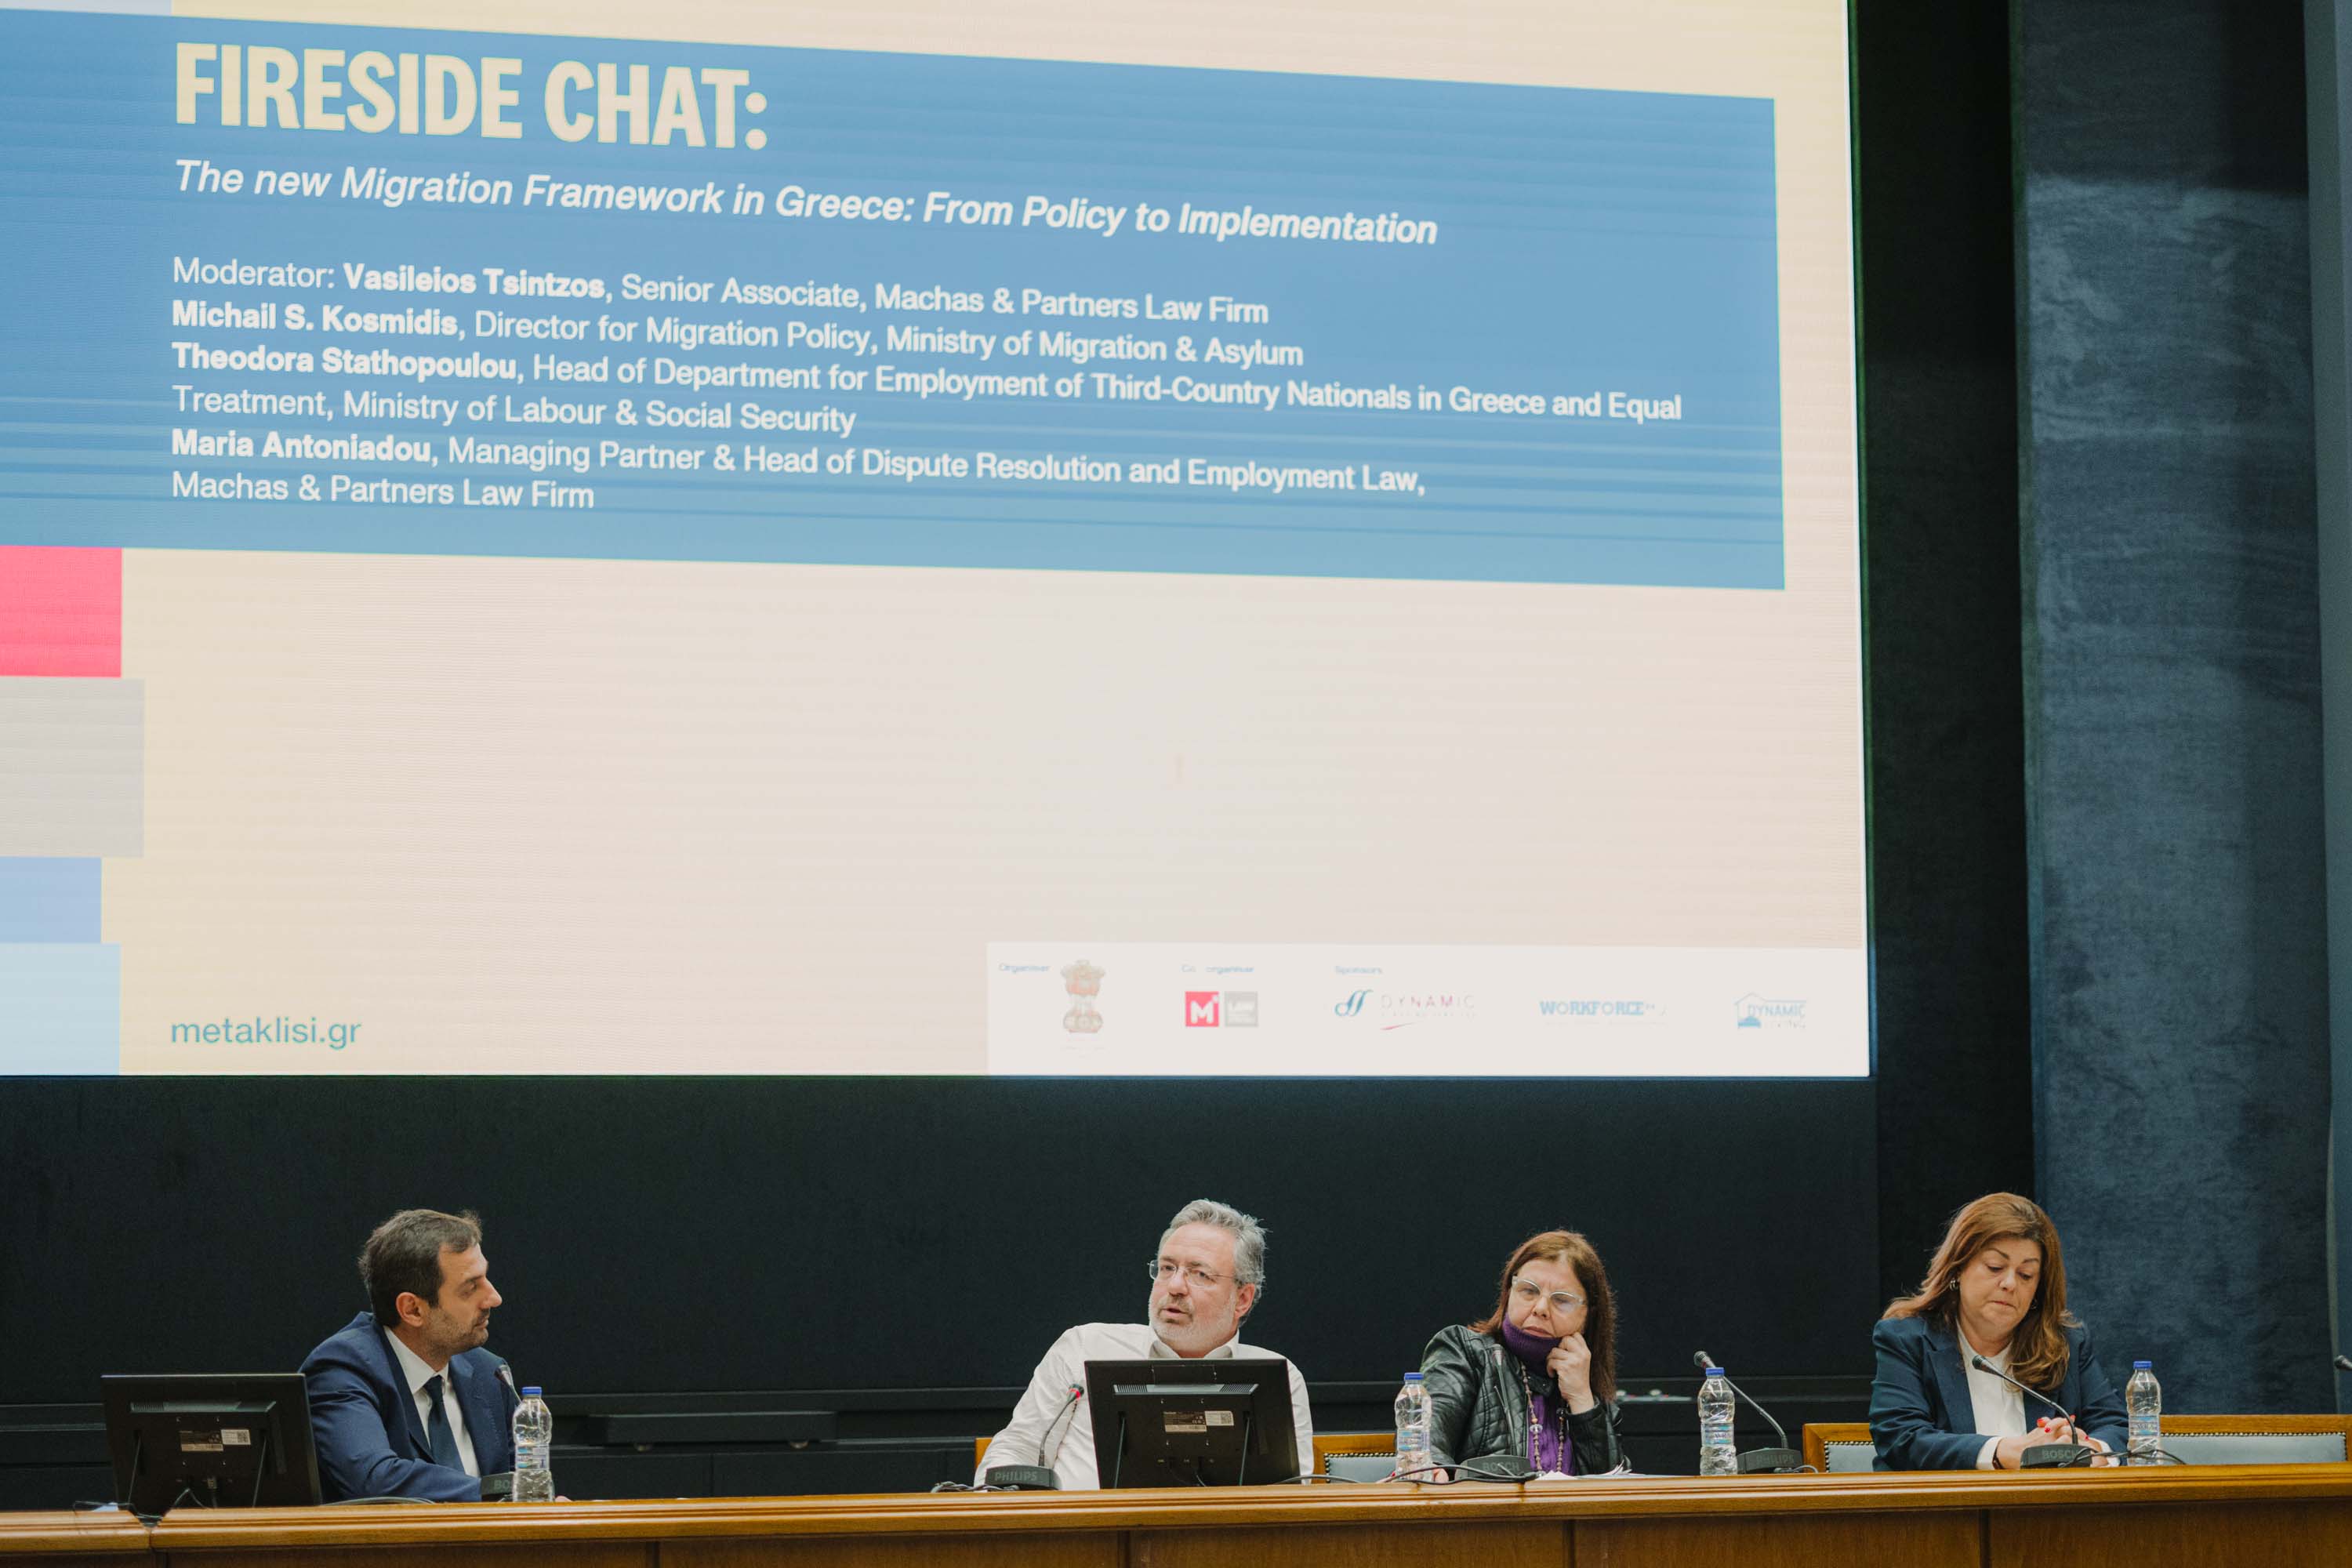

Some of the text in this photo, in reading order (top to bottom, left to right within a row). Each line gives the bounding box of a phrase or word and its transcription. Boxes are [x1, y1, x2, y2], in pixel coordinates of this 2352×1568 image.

[176, 42, 768, 151] FIRESIDE CHAT:
[175, 158, 1439, 245] The new Migration Framework in Greece: From Policy to Implementation
[173, 256, 1269, 325] Moderator: Vasileios Tsintzos, Senior Associate, Machas & Partners Law Firm
[172, 299, 1305, 372] Michail S. Kosmidis, Director for Migration Policy, Ministry of Migration & Asylum
[170, 340, 1682, 426] Theodora Stathopoulou, Head of Department for Employment of Third-Country Nationals in Greece and Equal
[172, 384, 858, 439] Treatment, Ministry of Labour & Social Security
[171, 427, 1426, 497] Maria Antoniadou, Managing Partner & Head of Dispute Resolution and Employment Law,
[172, 470, 595, 510] Machas & Partners Law Firm
[1381, 994, 1475, 1009] DYNAMIC
[1539, 1000, 1644, 1016] WORKFORCE
[1748, 1003, 1806, 1018] DYNAMIC
[171, 1016, 362, 1051] metaklisi.gr
[994, 1472, 1038, 1481] PHILIPS
